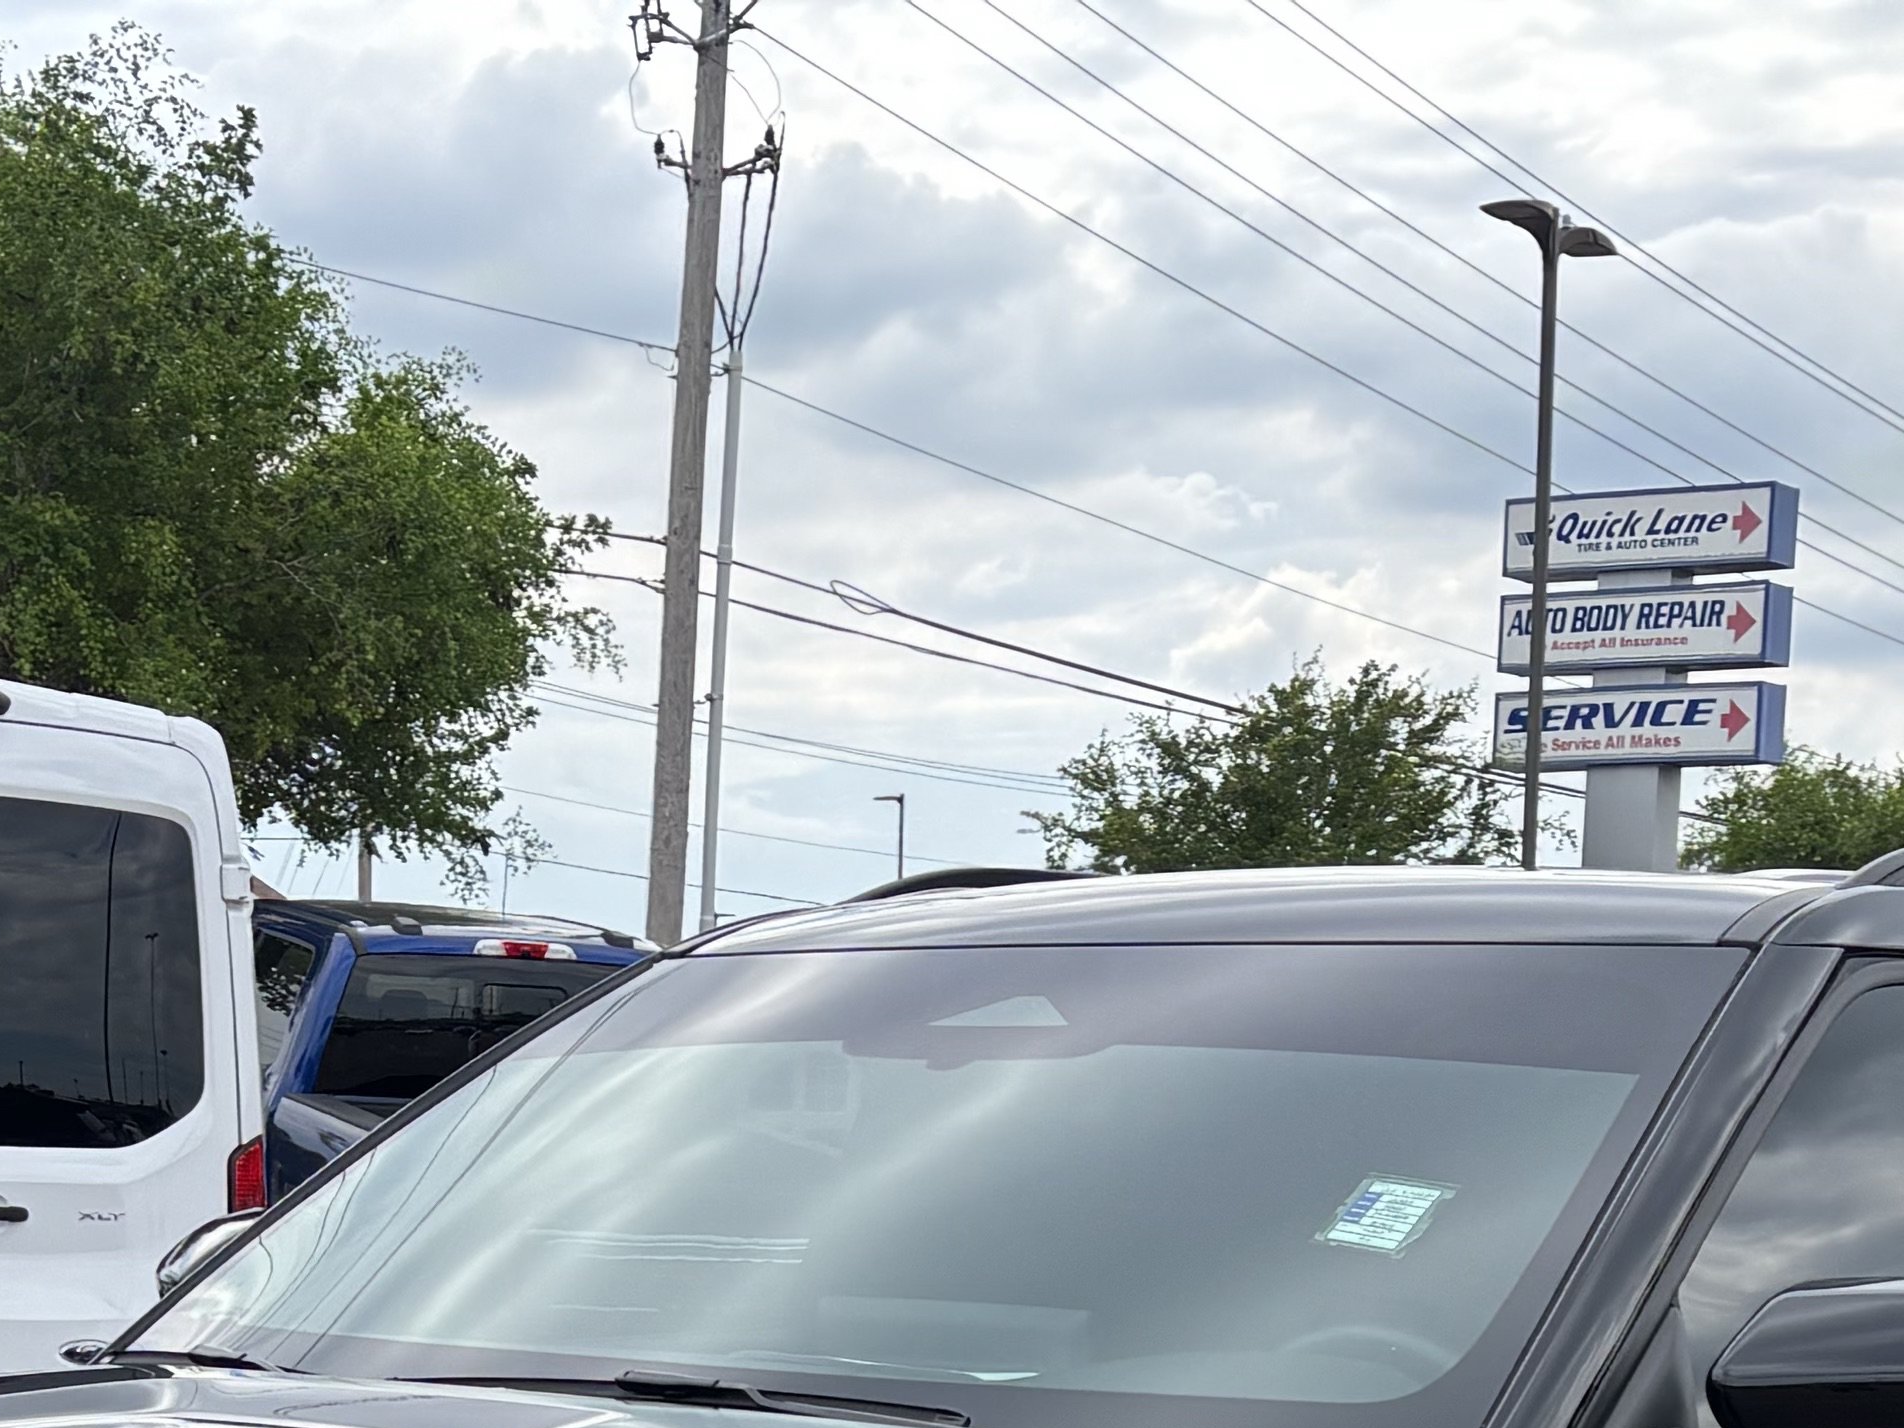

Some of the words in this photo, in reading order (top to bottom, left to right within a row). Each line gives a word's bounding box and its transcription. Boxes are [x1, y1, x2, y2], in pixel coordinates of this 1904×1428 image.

[1556, 509, 1645, 544] Quick
[1646, 508, 1728, 536] Lane
[1577, 542, 1602, 553] TIRE
[1605, 541, 1612, 551] &
[1616, 539, 1647, 550] AUTO
[1651, 536, 1698, 548] CENTER
[1570, 603, 1635, 633] BODY
[1636, 600, 1725, 629] REPAIR
[1551, 639, 1596, 652] Accept
[1599, 637, 1617, 649] All
[1620, 634, 1688, 648] Insurance
[1503, 698, 1717, 734] SERVICE
[1551, 737, 1601, 752] Service
[1604, 735, 1625, 750] All
[1629, 733, 1681, 749] Makes
[78, 1209, 126, 1221] XLT
